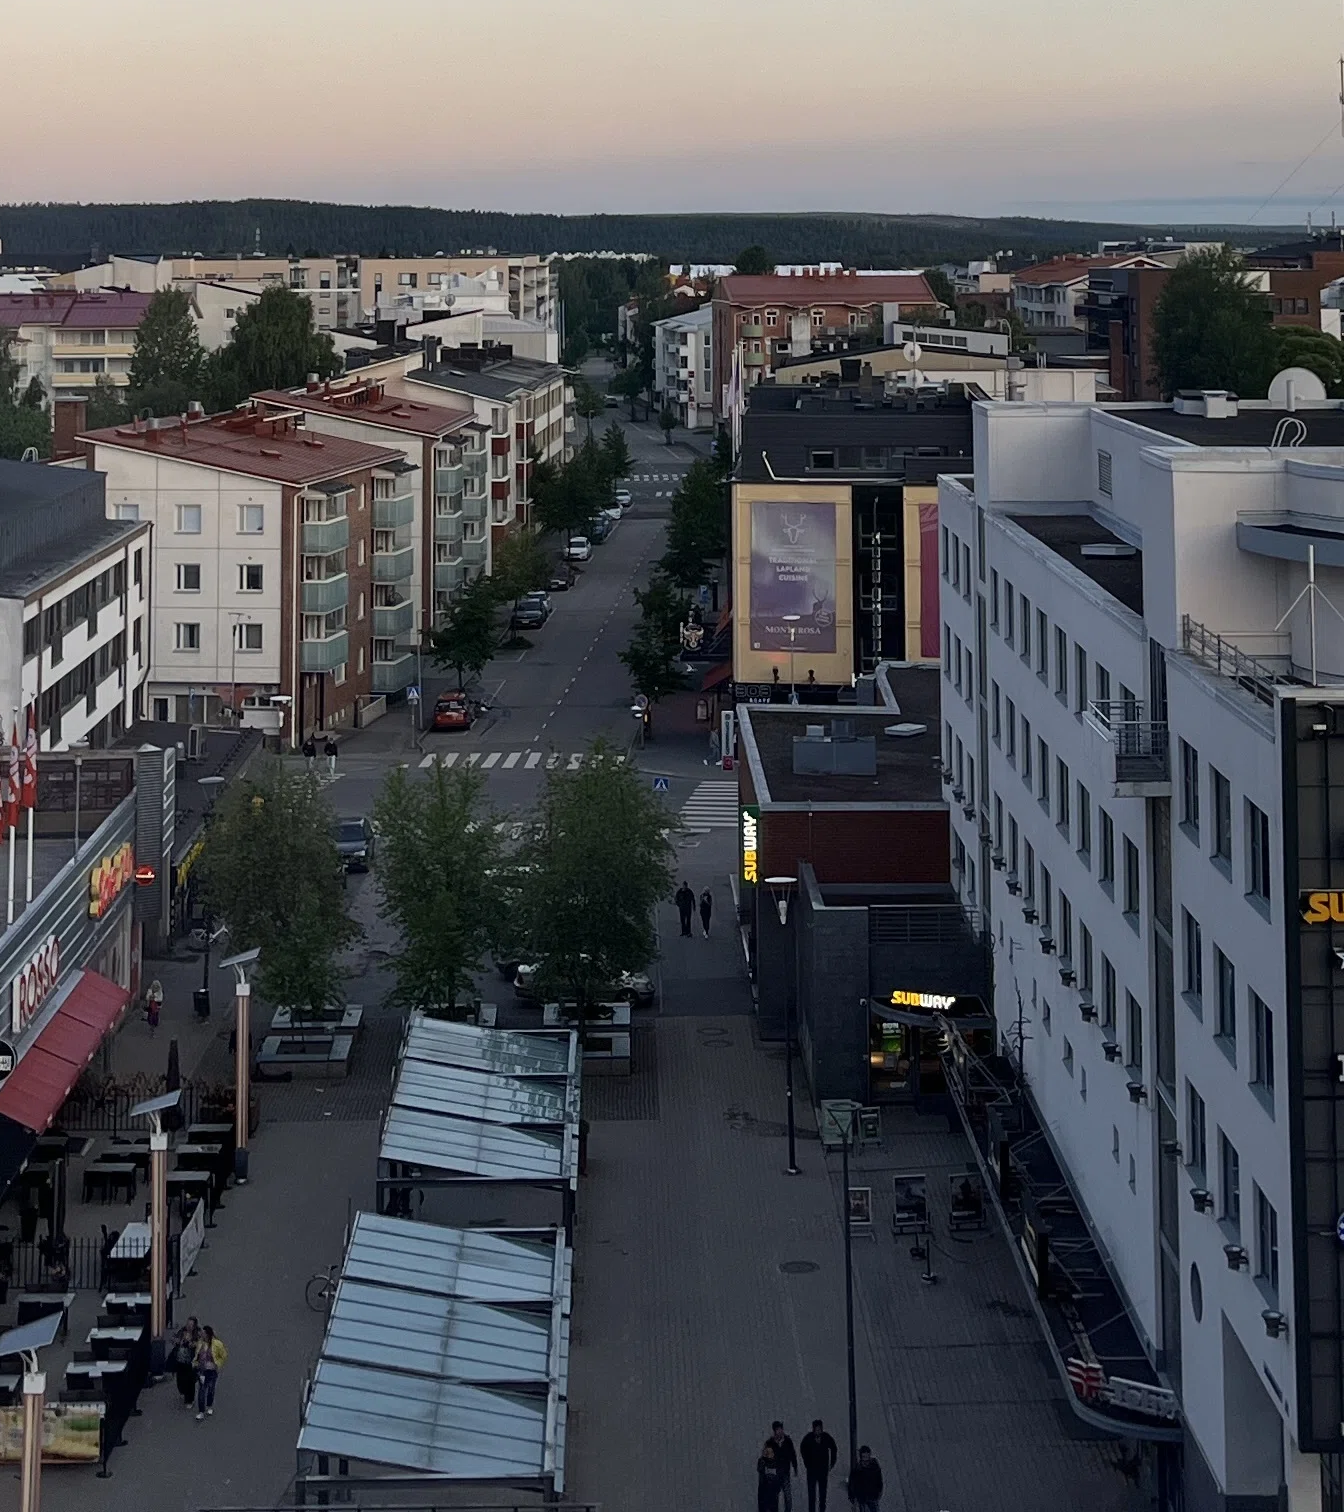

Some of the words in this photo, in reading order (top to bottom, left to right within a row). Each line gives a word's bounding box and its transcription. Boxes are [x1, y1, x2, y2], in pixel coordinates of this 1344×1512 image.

[776, 565, 811, 573] LAPLAND
[778, 574, 809, 582] CUISINE
[764, 625, 794, 635] MONT
[798, 627, 822, 635] ROSA
[743, 810, 757, 884] SUBWAY
[11, 934, 60, 1034] ROSSO
[890, 990, 956, 1010] SUBWAY
